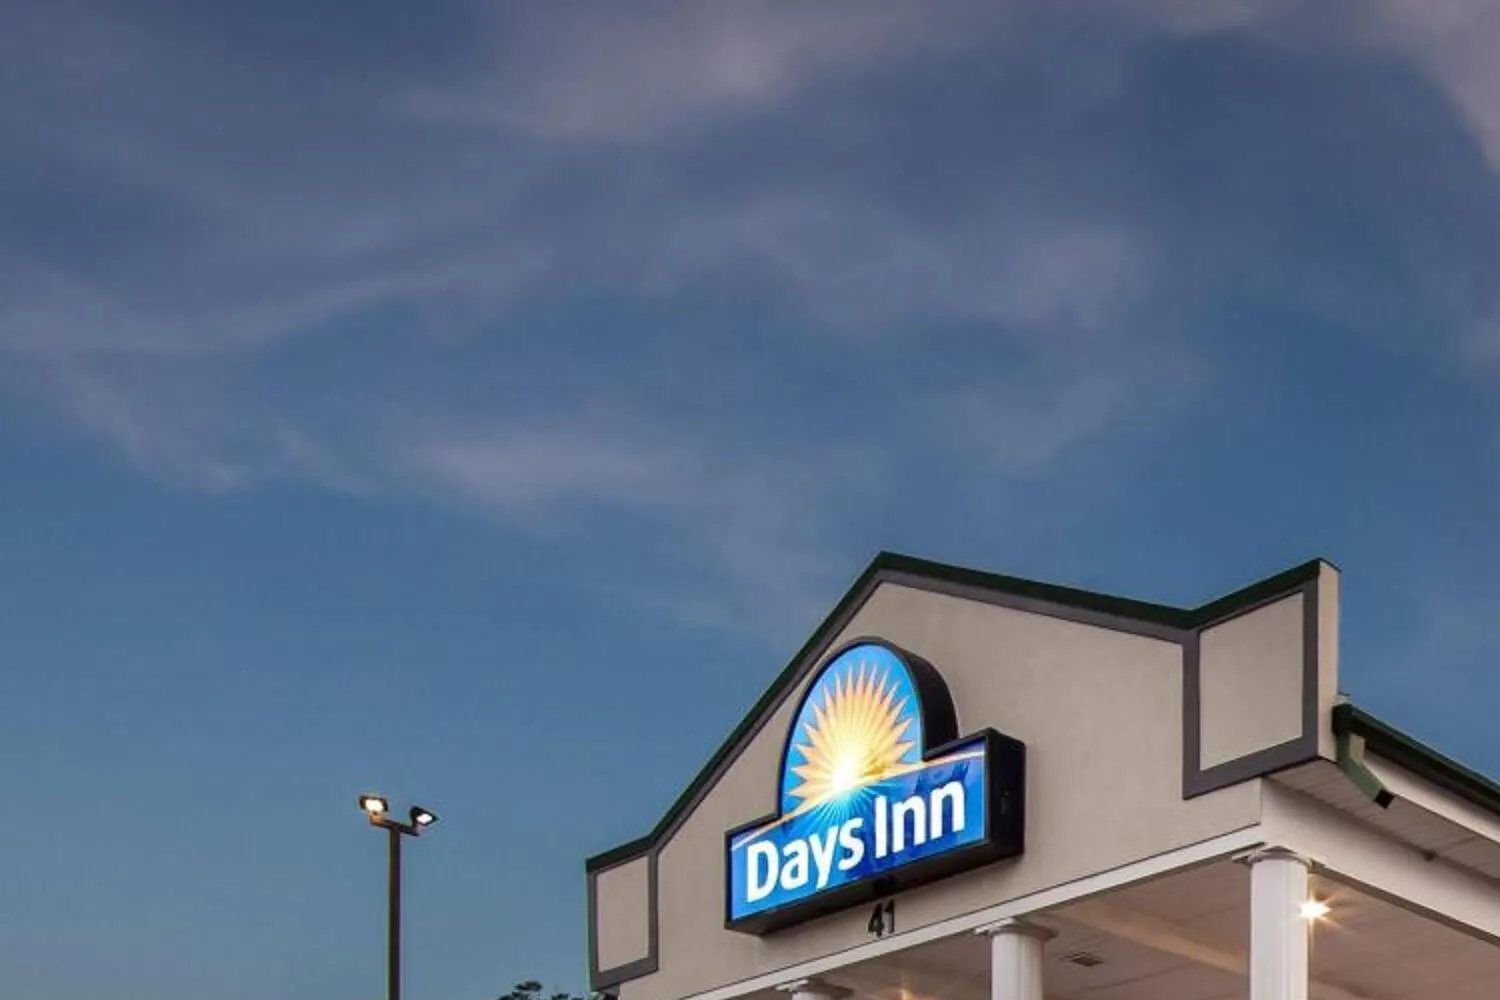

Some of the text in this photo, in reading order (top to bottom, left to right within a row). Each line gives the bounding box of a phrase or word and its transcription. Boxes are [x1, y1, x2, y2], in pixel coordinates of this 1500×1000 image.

[746, 780, 966, 902] Days Inn
[867, 899, 896, 936] 41
